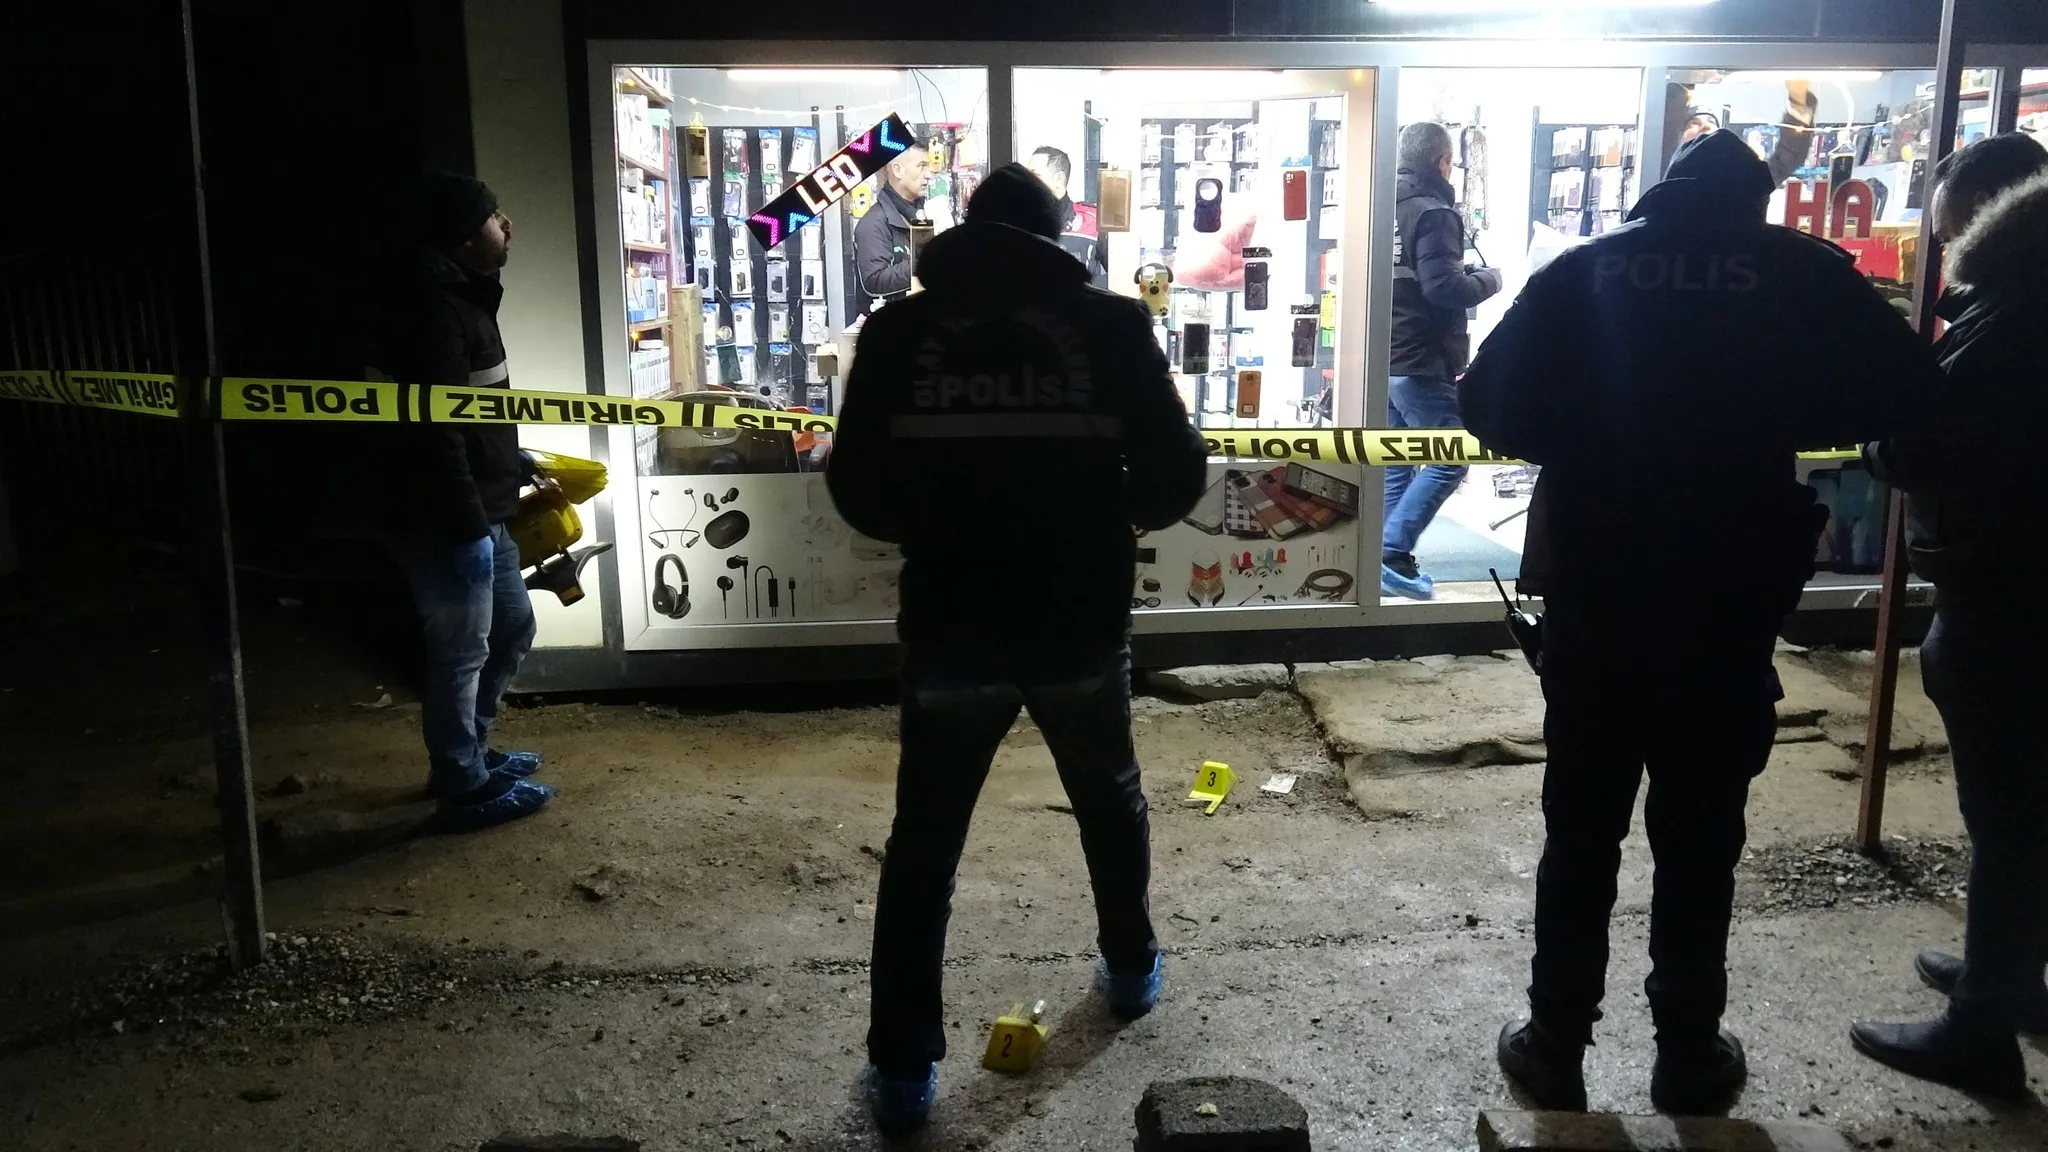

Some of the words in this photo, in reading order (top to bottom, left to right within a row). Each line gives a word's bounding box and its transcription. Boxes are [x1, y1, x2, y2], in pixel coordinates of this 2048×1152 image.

[796, 153, 862, 216] LED
[1784, 178, 1875, 240] HA
[241, 383, 380, 415] POLİS
[446, 392, 666, 425] GİRİLMEZ
[1207, 771, 1217, 787] 3
[1001, 1032, 1013, 1058] 2
